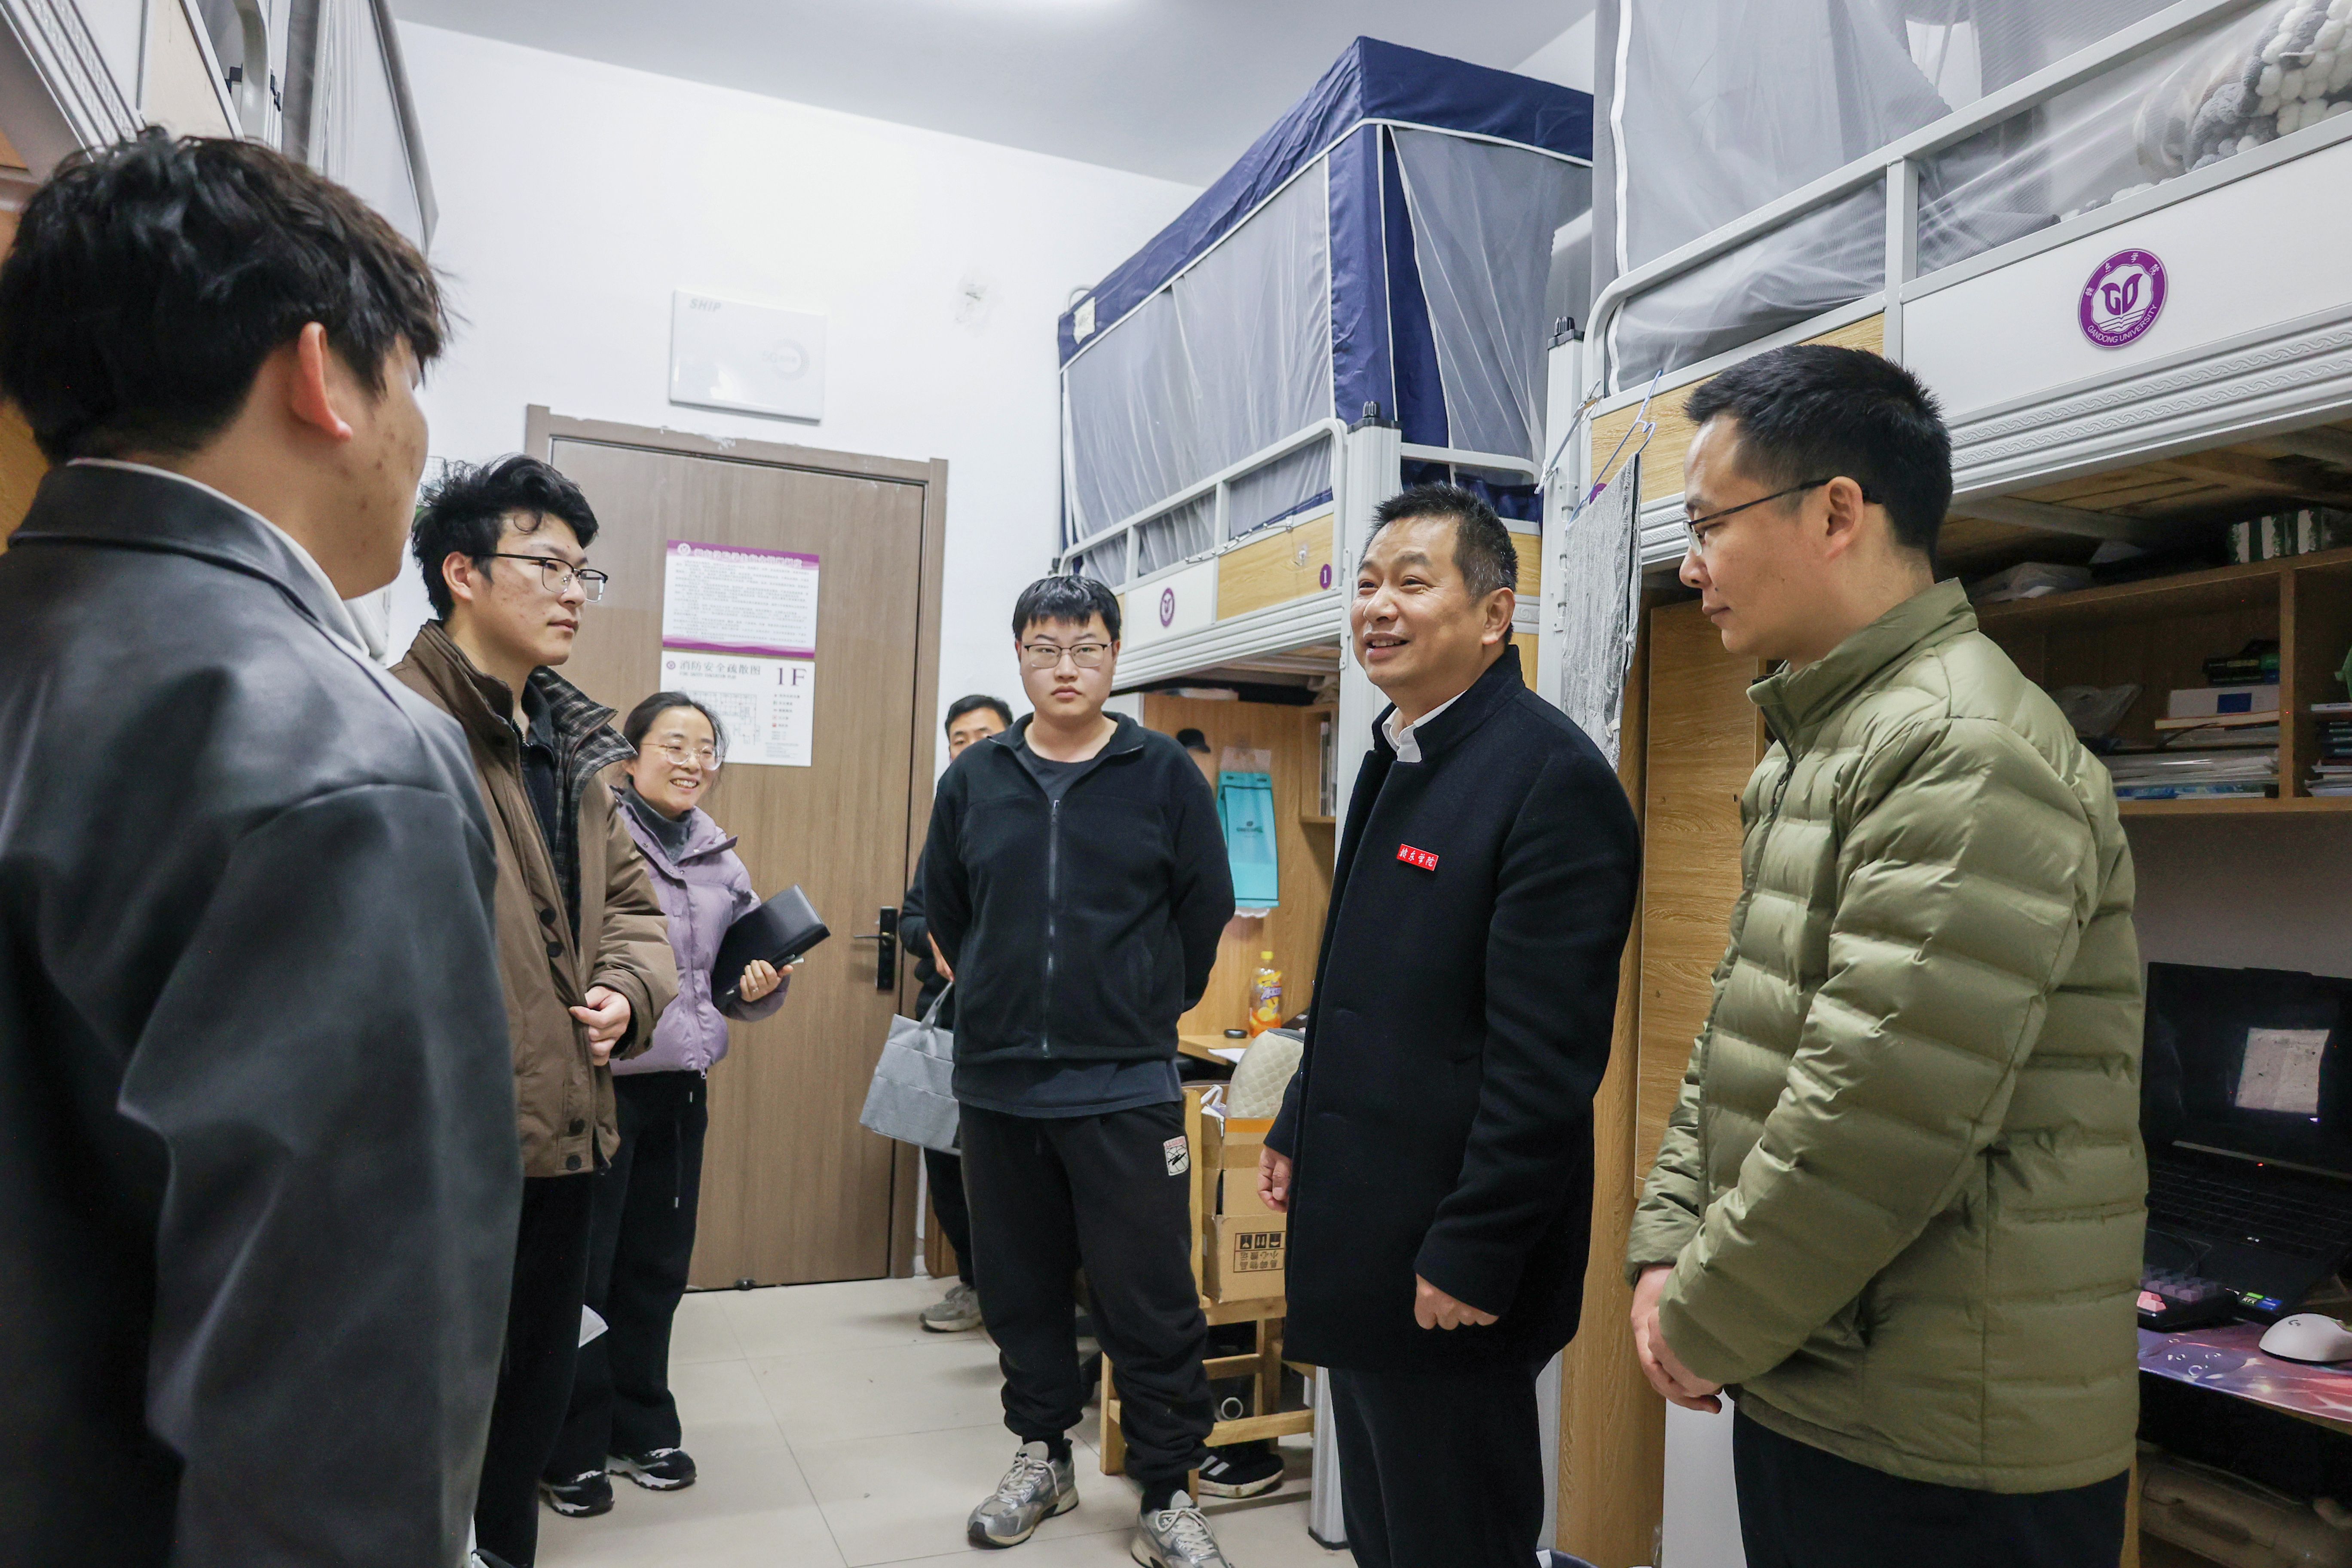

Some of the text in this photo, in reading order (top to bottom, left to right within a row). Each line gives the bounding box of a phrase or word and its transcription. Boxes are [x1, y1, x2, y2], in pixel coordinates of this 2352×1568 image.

[689, 298, 722, 312] SHIP
[2119, 304, 2157, 341] UNIVERSITY
[680, 660, 760, 675] 消防安全疏散图
[775, 668, 807, 686] 1F
